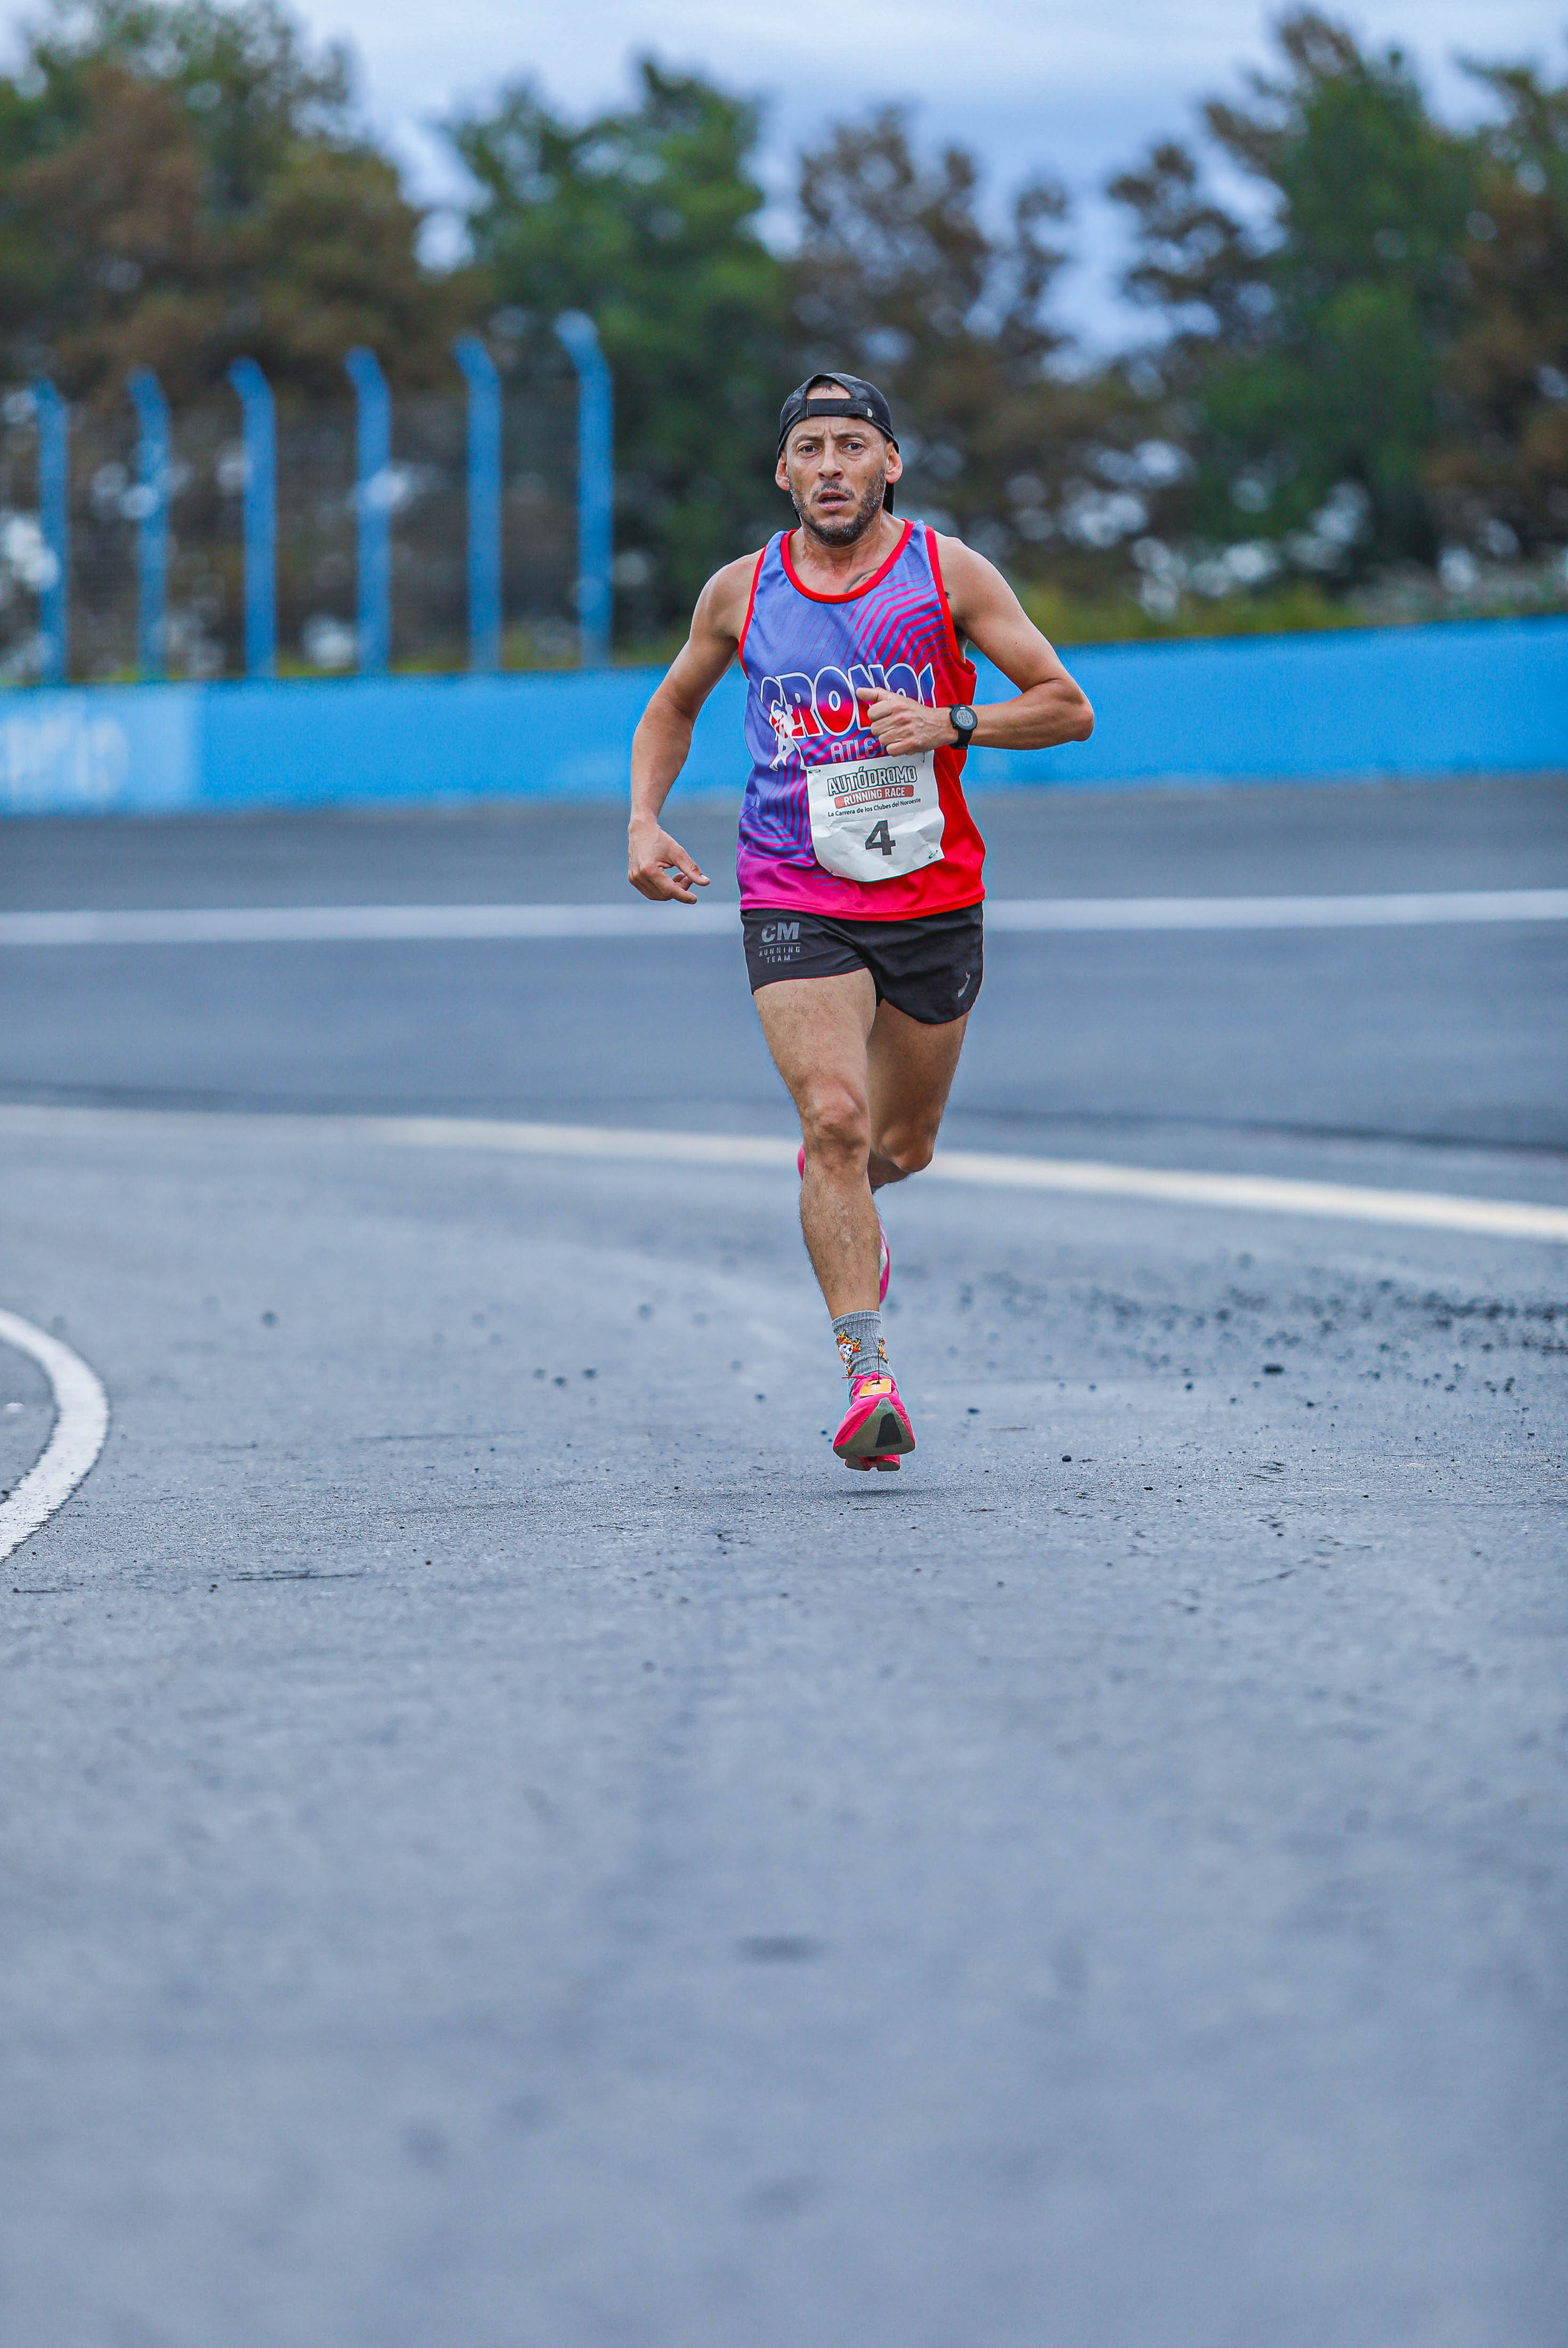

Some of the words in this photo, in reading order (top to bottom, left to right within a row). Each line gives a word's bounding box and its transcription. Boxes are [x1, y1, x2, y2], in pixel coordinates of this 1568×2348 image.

[827, 766, 917, 797] AUTÓDROMO
[843, 789, 882, 807] RUNNING
[884, 786, 905, 798] RACE
[900, 798, 921, 806] Noroeste
[865, 819, 896, 856] 4
[761, 922, 800, 943] CM
[759, 946, 800, 957] RUNNING
[766, 954, 791, 964] TEAM
